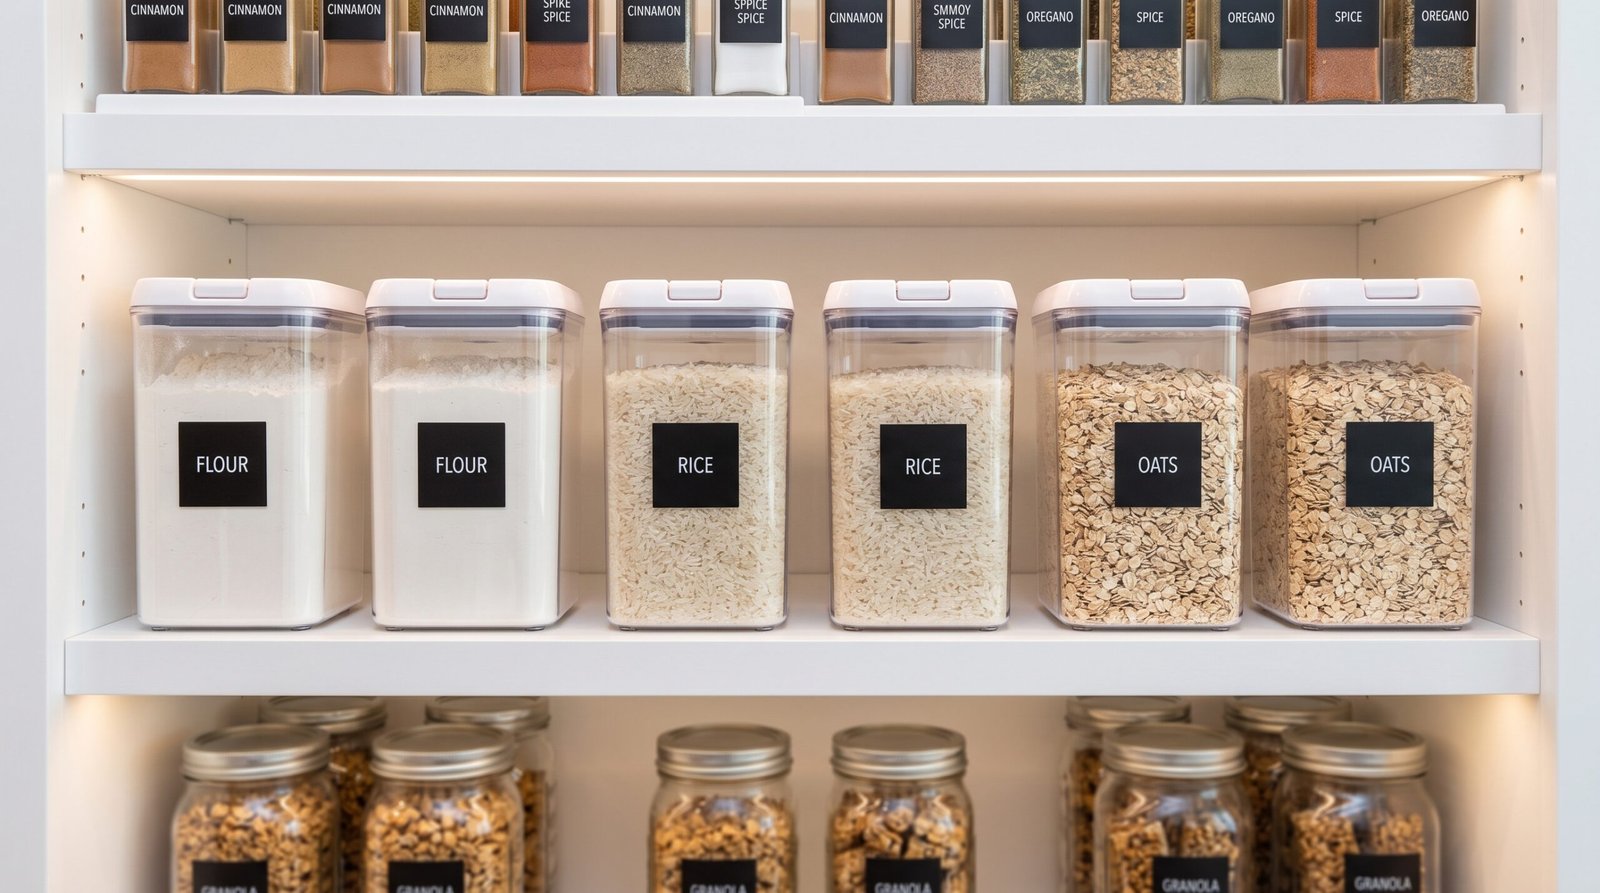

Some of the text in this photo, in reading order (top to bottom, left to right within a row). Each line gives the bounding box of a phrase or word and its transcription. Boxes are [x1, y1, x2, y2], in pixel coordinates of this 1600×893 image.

[130, 3, 184, 16] CINNAMON
[227, 3, 282, 16] CINNAMON
[327, 3, 381, 16] CINNAMON
[429, 4, 484, 17] CINNAMON
[543, 0, 571, 9] SPIKE
[627, 4, 681, 17] CINNAMON
[734, 0, 768, 10] SPPICE
[933, 4, 972, 16] SMMOY
[543, 11, 571, 23] SPICE
[737, 12, 765, 24] SPICE
[829, 11, 883, 24] CINNAMON
[1026, 11, 1074, 23] OREGANO
[1136, 11, 1164, 24] SPICE
[1227, 11, 1275, 24] OREGANO
[1334, 11, 1363, 23] SPICE
[1421, 10, 1470, 22] OREGANO
[938, 17, 966, 30] SPICE
[196, 455, 249, 474] FLOUR
[435, 456, 488, 475] FLOUR
[678, 456, 714, 475] RICE
[905, 457, 942, 476] RICE
[1137, 456, 1179, 474] OATS
[1370, 455, 1411, 474] OATS
[874, 882, 932, 893] GRANOLA
[1162, 878, 1220, 893] GRANOLA
[1354, 876, 1412, 891] GRANOLA
